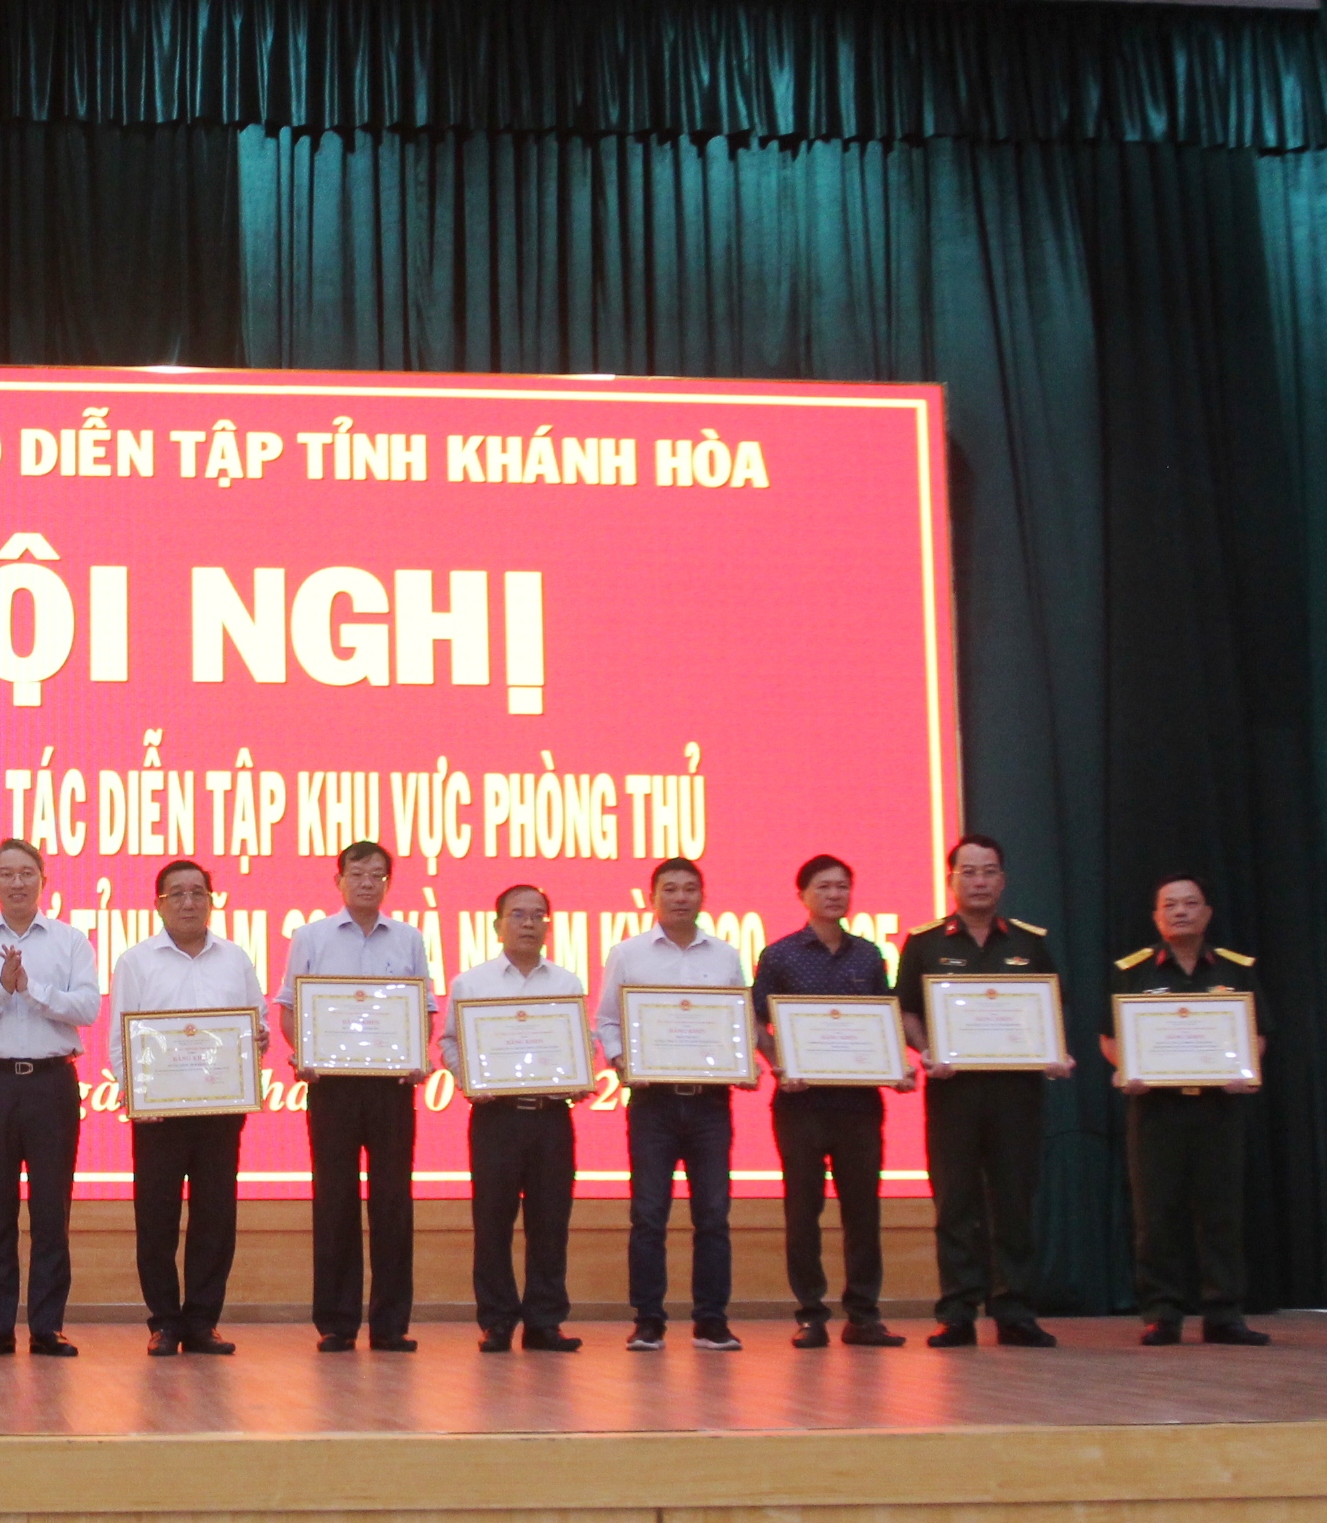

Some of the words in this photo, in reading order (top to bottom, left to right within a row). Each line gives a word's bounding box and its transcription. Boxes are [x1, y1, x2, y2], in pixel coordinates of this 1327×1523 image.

[21, 406, 154, 477] DIỄN
[169, 419, 284, 488] TẬP
[297, 415, 427, 482] TỈNH
[447, 424, 637, 486] KHÁNH
[656, 428, 770, 489] HÒA
[191, 566, 545, 715] NGHỊ
[5, 746, 86, 856] TÁC
[99, 728, 195, 856] DIỄN
[205, 747, 286, 874] TẬP
[297, 771, 379, 857] KHU
[390, 755, 472, 875] VỰC
[484, 749, 618, 860] PHÒNG
[625, 742, 706, 861] THỦ
